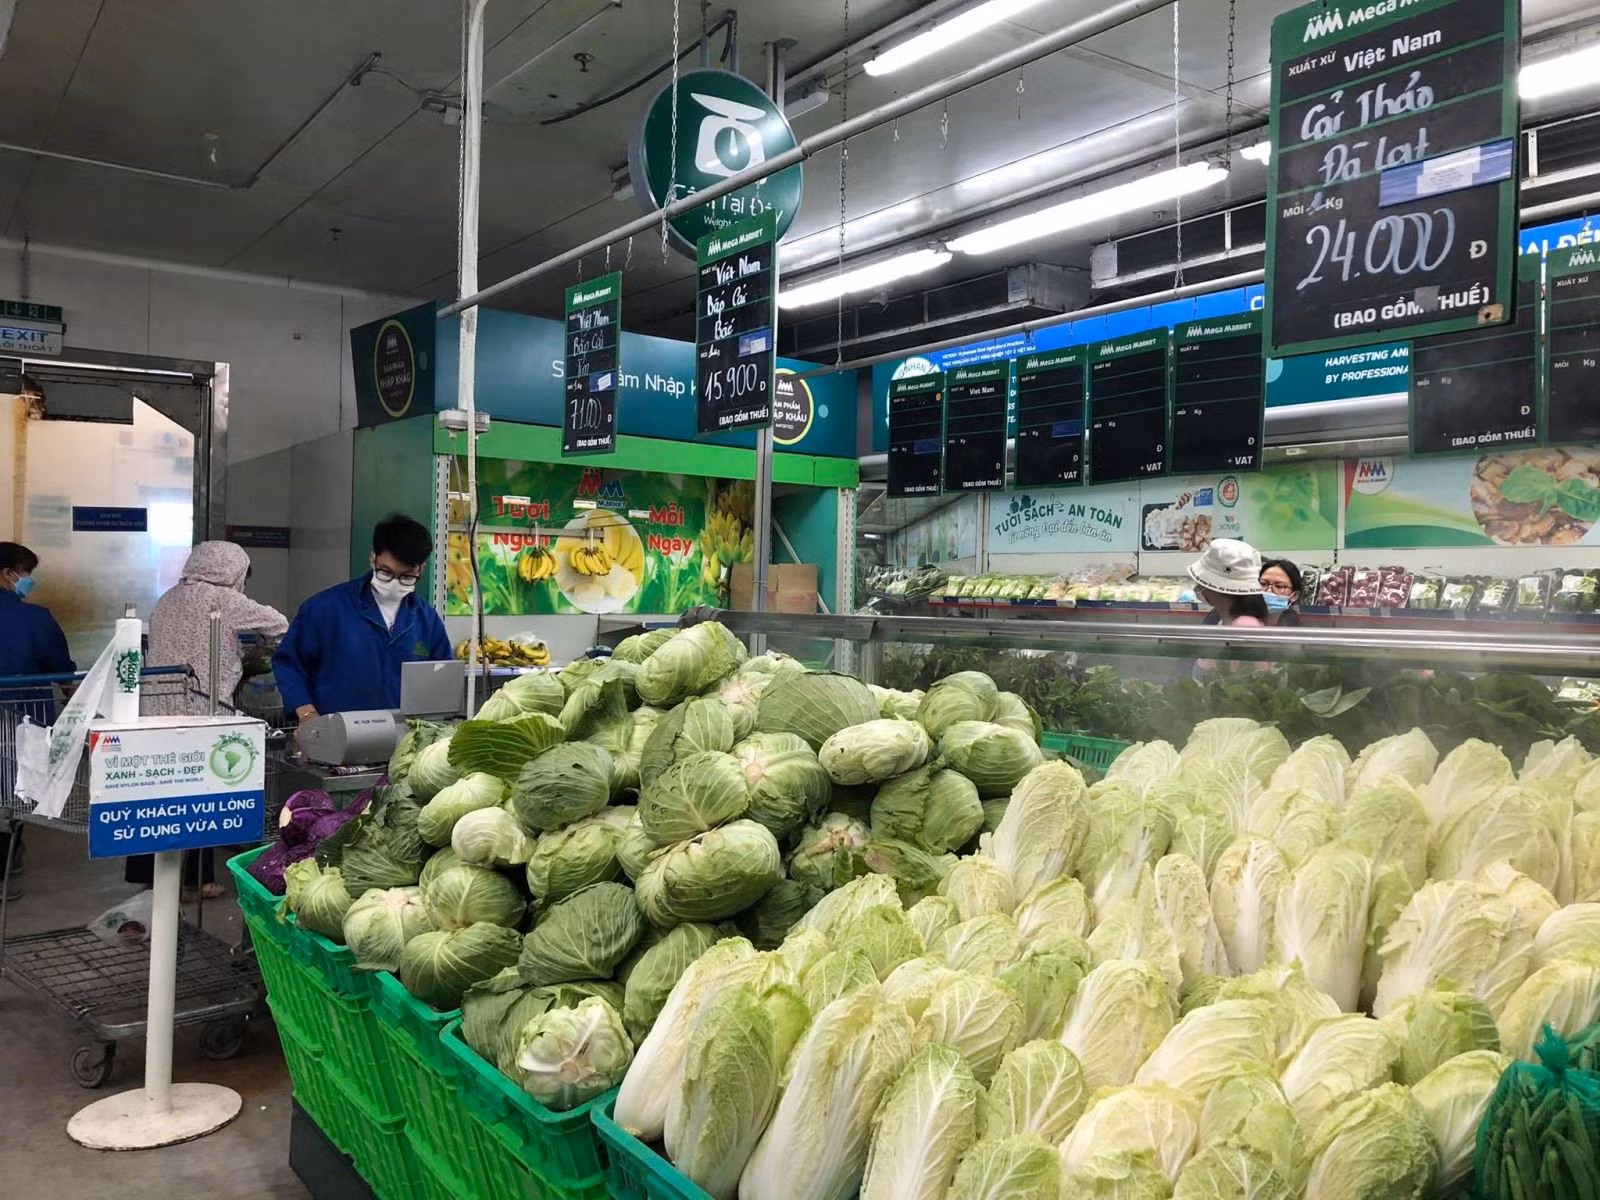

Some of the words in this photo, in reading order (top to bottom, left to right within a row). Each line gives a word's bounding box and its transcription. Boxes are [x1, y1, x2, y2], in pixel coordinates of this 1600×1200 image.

[1288, 58, 1317, 77] XUẤT
[1344, 47, 1386, 73] Việt
[1392, 30, 1442, 57] Nam
[1326, 196, 1344, 210] Kg
[1296, 207, 1456, 291] 24.000
[1469, 240, 1488, 259] Đ
[739, 255, 761, 278] Nam
[1334, 308, 1376, 329] (BAO
[1438, 282, 1490, 310] HUẾ)
[2, 329, 49, 343] EXIT
[1325, 349, 1388, 367] HARVESTING
[1583, 358, 1596, 368] Kg
[704, 363, 758, 402] 15.900
[1325, 374, 1339, 384] BY
[1341, 365, 1409, 382] PROFESSIONA
[645, 373, 686, 399] Nhập
[1520, 405, 1531, 415] Đ
[1452, 435, 1476, 447] (BAO
[1146, 462, 1162, 472] VAT
[1235, 456, 1253, 465] VAT
[1064, 471, 1078, 480] VAT
[649, 502, 685, 526] Mỗi
[1024, 504, 1054, 522] SẠCH
[1068, 504, 1086, 518] AN
[1090, 507, 1123, 529] TOÀN
[647, 533, 693, 557] Ngày
[121, 755, 149, 769] MỘT
[105, 770, 136, 781] XANH
[146, 768, 175, 780] SẠCH
[183, 766, 205, 777] ĐẸP
[100, 807, 132, 824] QUÝ
[136, 804, 187, 820] KHÁCH
[192, 801, 216, 813] VUI
[219, 797, 256, 812] LÒNG
[113, 824, 135, 841] SỬ
[140, 823, 181, 840] DỤNG
[185, 818, 218, 833] VỪA
[222, 814, 244, 830] ĐỦ
